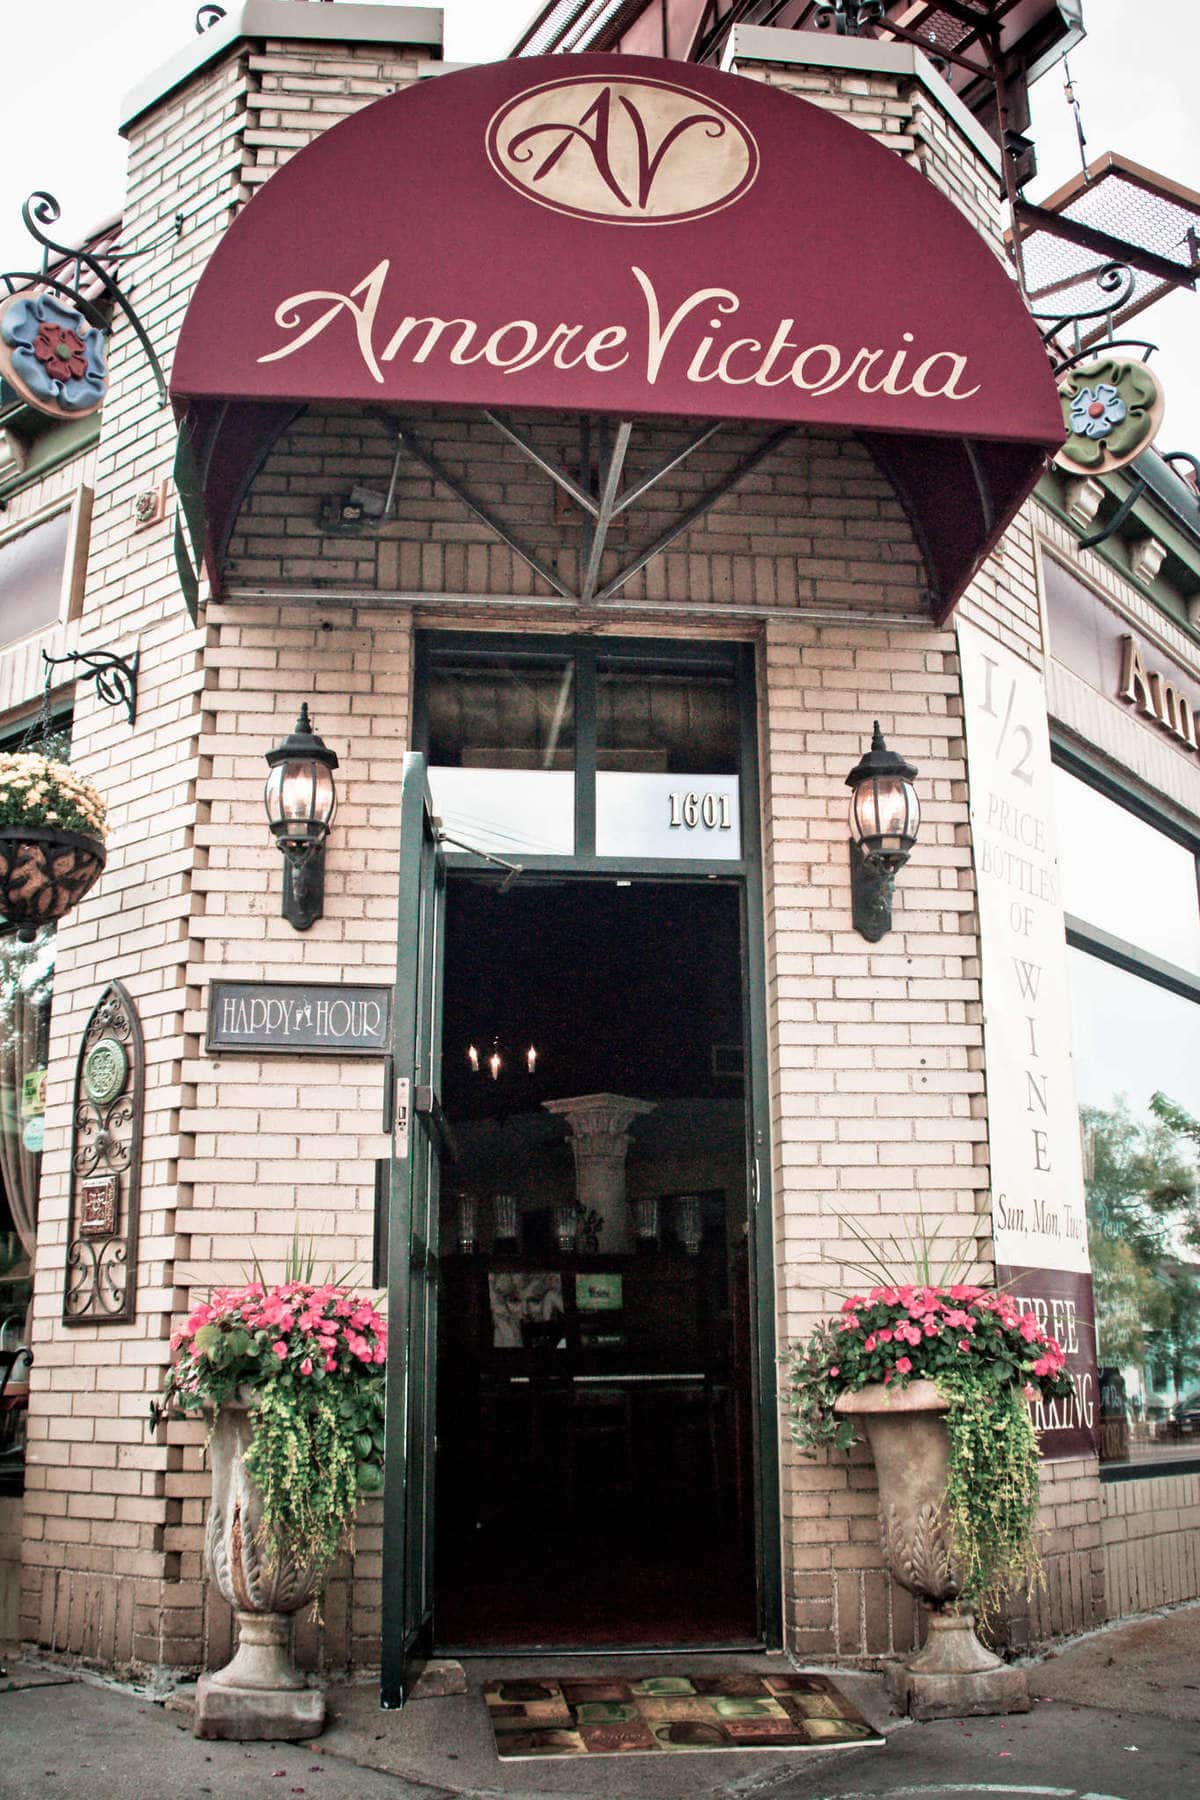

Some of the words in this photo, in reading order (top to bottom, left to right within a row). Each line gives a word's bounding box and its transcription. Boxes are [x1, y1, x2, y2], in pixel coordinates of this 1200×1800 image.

[257, 259, 628, 384] Amore
[632, 265, 981, 399] Victoria
[980, 654, 1034, 785] 1/2
[1119, 634, 1200, 752] Am
[669, 792, 731, 829] 1601
[987, 792, 1045, 853] PRICE
[979, 839, 1058, 906] BOTTLES
[1009, 902, 1035, 936] OF
[222, 998, 294, 1035] HAPPY
[316, 1000, 382, 1037] HOUR
[998, 1193, 1028, 1238] Sun,
[1032, 1198, 1061, 1240] Mon,
[1026, 1373, 1093, 1430] RKING
